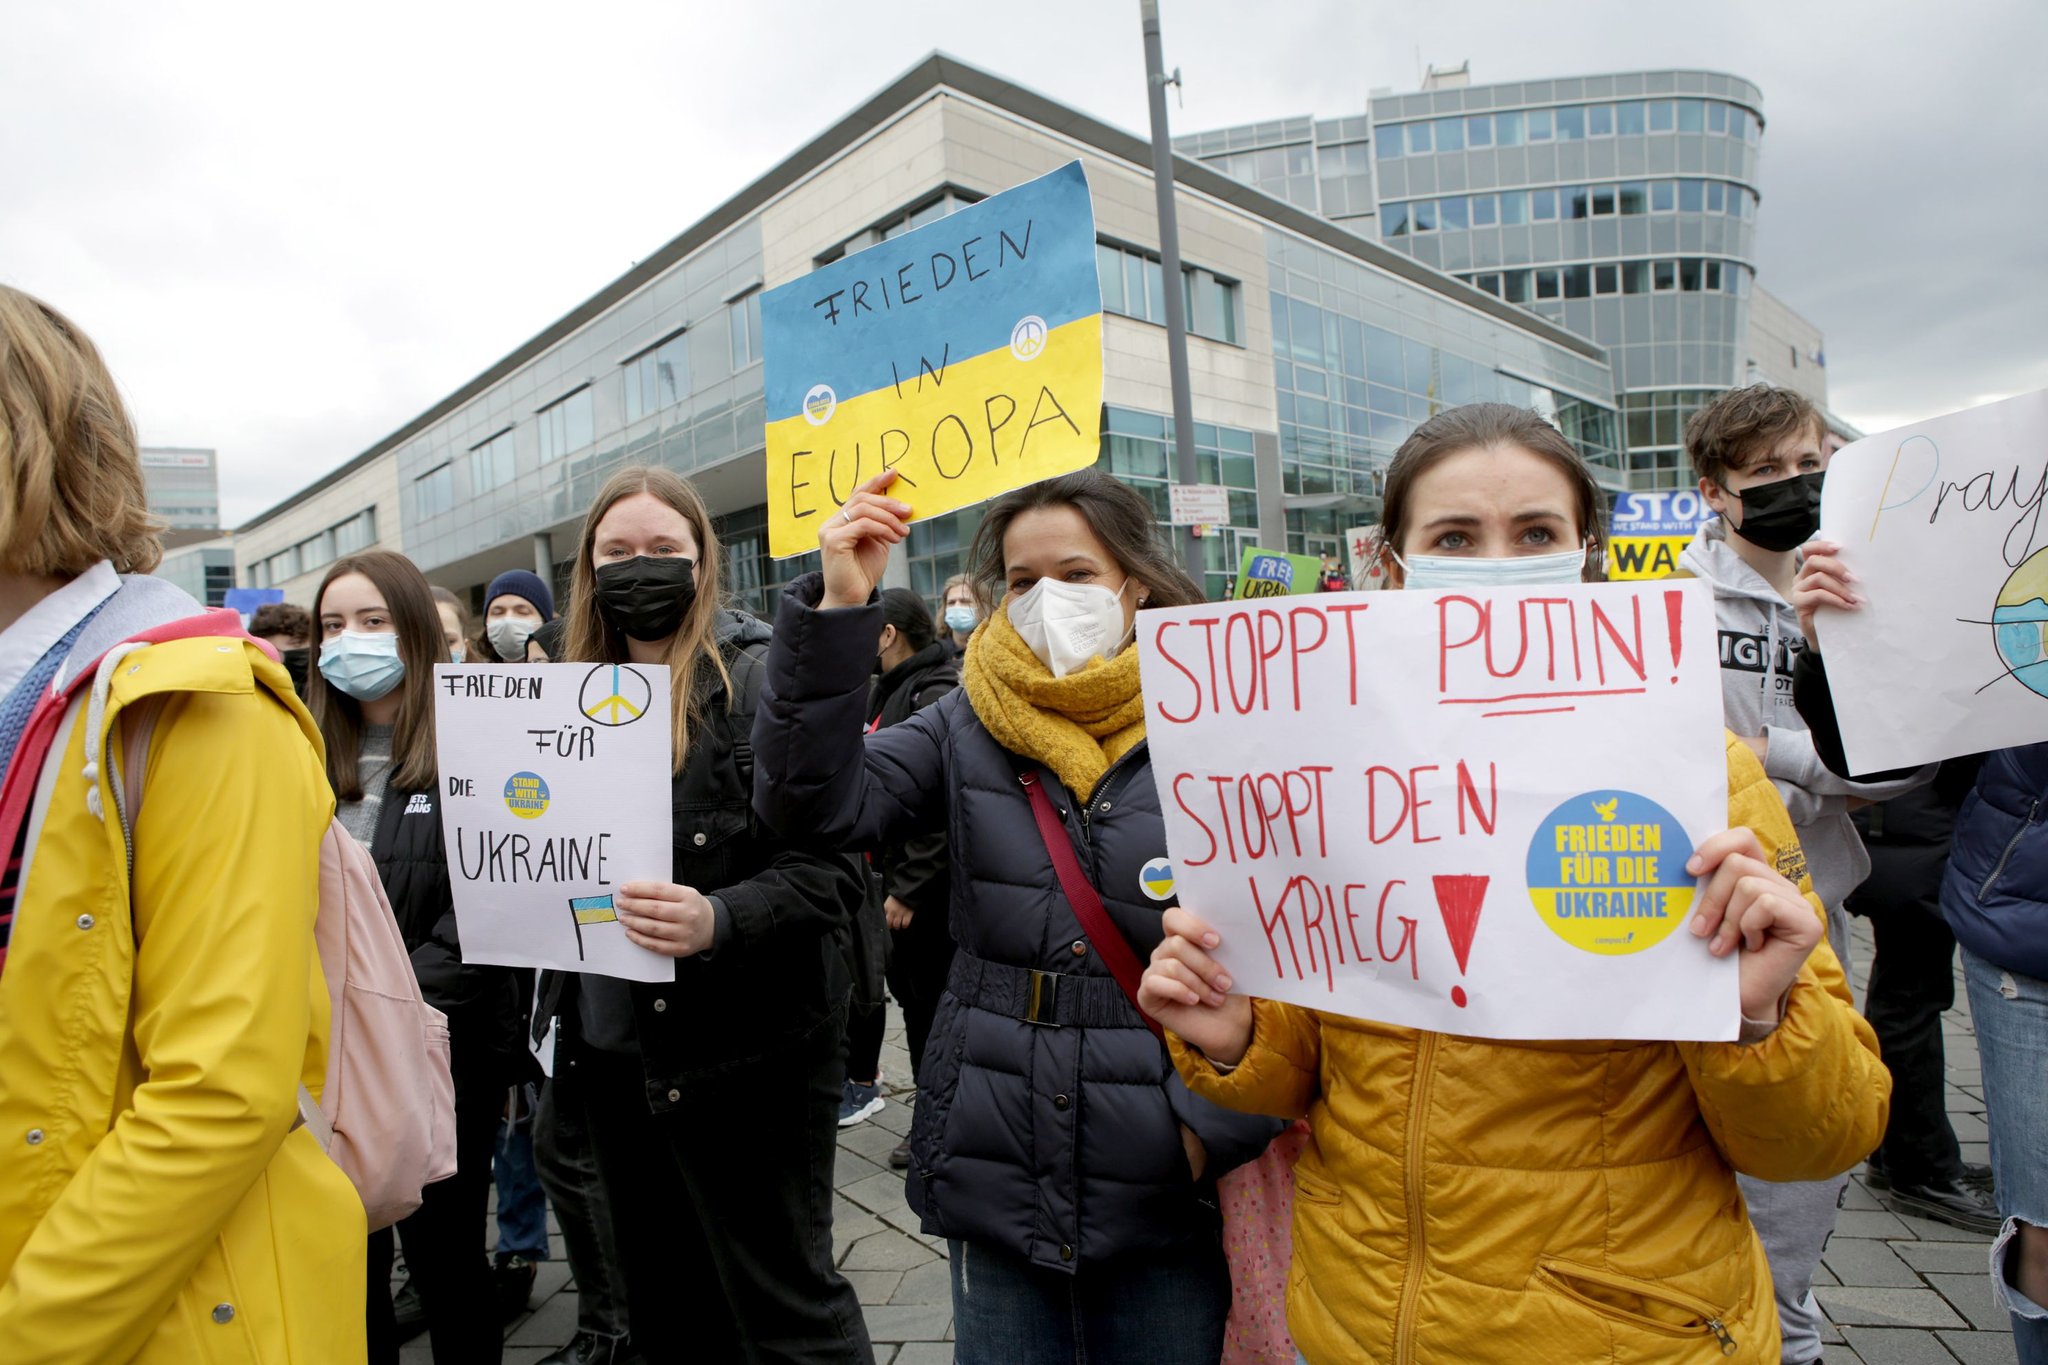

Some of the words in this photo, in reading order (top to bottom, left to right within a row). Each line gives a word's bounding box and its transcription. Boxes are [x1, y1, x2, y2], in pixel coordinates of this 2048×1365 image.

[813, 219, 1033, 326] FRIEDEN
[891, 342, 950, 400] IN
[791, 385, 1081, 518] EUROPA
[1867, 434, 2048, 568] Pray
[1632, 522, 1660, 531] STAND
[1662, 521, 1692, 530] WITH
[1257, 557, 1292, 582] FREE
[1613, 543, 1690, 573] WA
[1156, 603, 1369, 724] STOPPT
[1436, 590, 1685, 694] PUTIN!
[441, 674, 544, 700] FRIEDEN
[527, 725, 595, 761] FÜR
[449, 776, 476, 798] DIE
[513, 777, 539, 788] STAND
[515, 788, 538, 799] WITH
[508, 799, 545, 810] UKRAINE
[1172, 766, 1334, 867] STOPPT
[1365, 759, 1498, 845] DEN
[1555, 824, 1662, 852] FRIEDEN
[457, 827, 612, 886] UKRAINE
[1560, 852, 1611, 885] FÜR
[1616, 856, 1659, 884] DIE
[1555, 891, 1668, 918] UKRAINE
